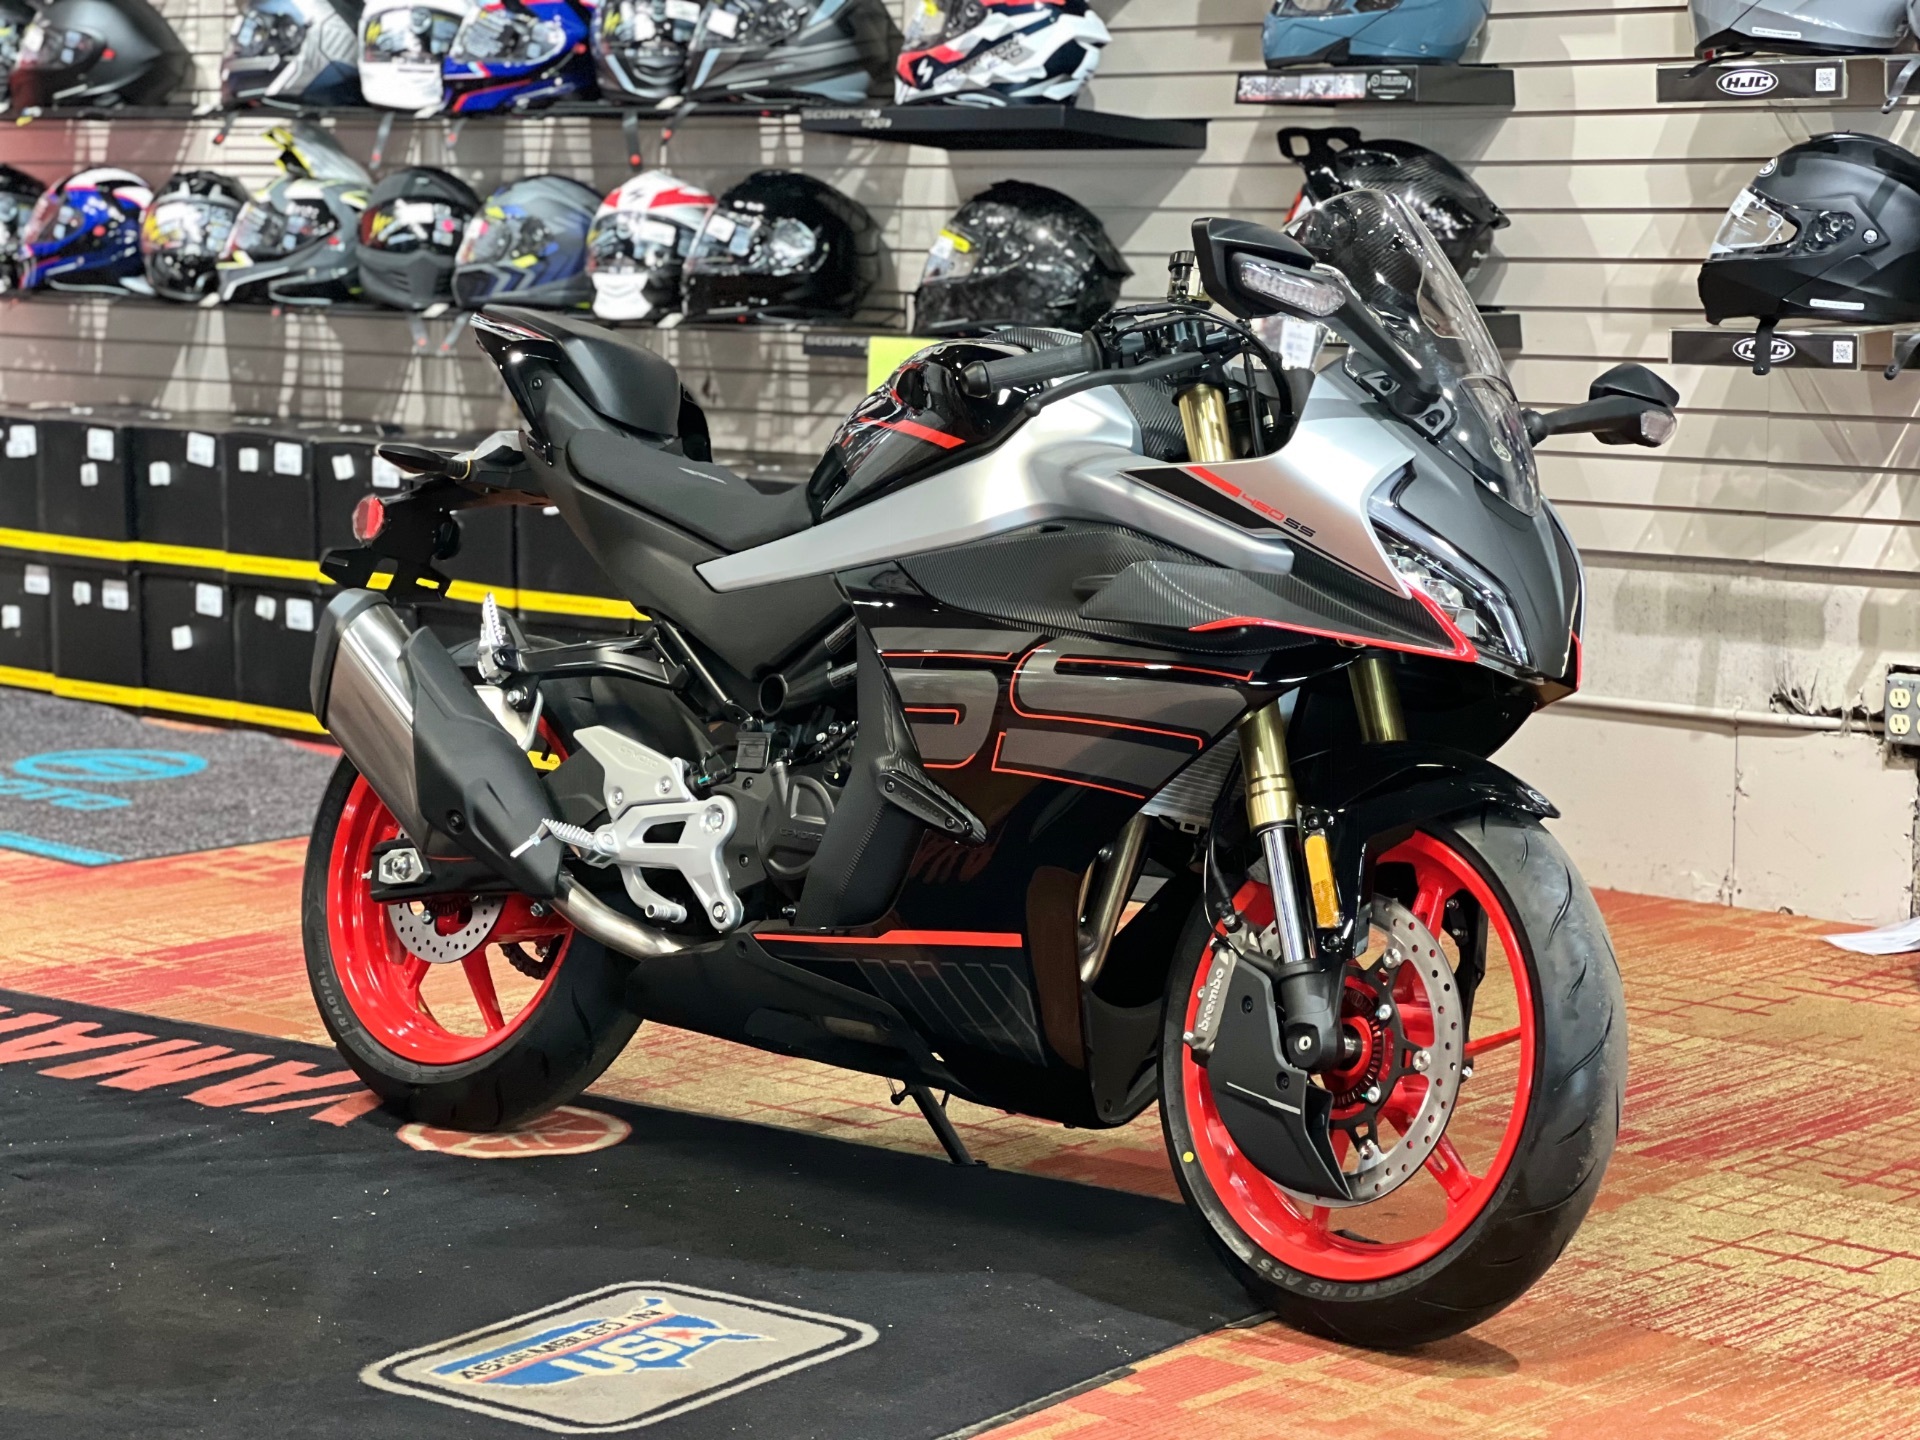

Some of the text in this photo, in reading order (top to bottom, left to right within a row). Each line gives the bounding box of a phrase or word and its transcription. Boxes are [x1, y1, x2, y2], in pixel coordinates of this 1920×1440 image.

[1725, 76, 1769, 89] HJC
[1741, 343, 1787, 356] HC
[318, 966, 350, 1028] RADIAL
[1197, 967, 1226, 1032] brembo
[460, 1308, 664, 1380] ASSEMBLED IN
[548, 1326, 738, 1376] USA
